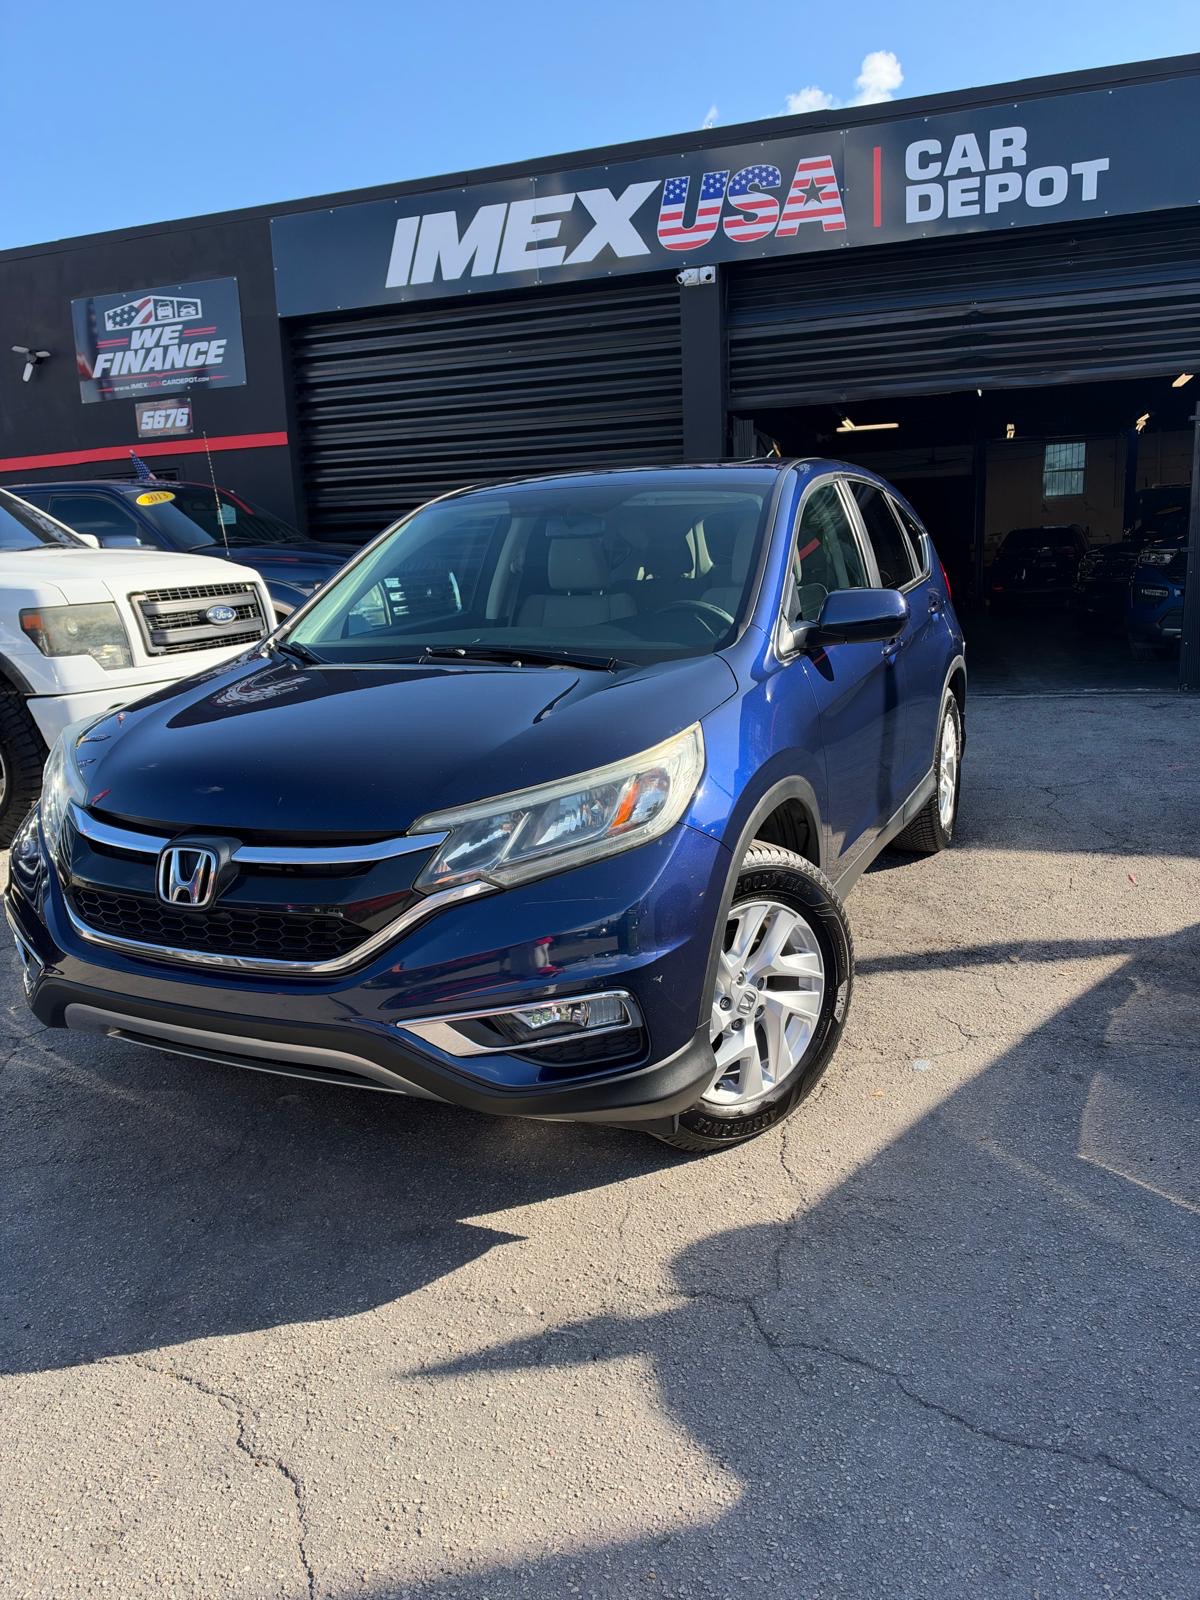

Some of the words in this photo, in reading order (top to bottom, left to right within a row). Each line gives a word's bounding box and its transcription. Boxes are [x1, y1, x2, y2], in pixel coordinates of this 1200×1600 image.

[905, 126, 1028, 181] CAR
[905, 157, 1110, 224] DEPOT
[130, 324, 183, 350] WE
[92, 338, 228, 379] FINANCE
[140, 407, 189, 430] 5676
[209, 608, 233, 621] Ford
